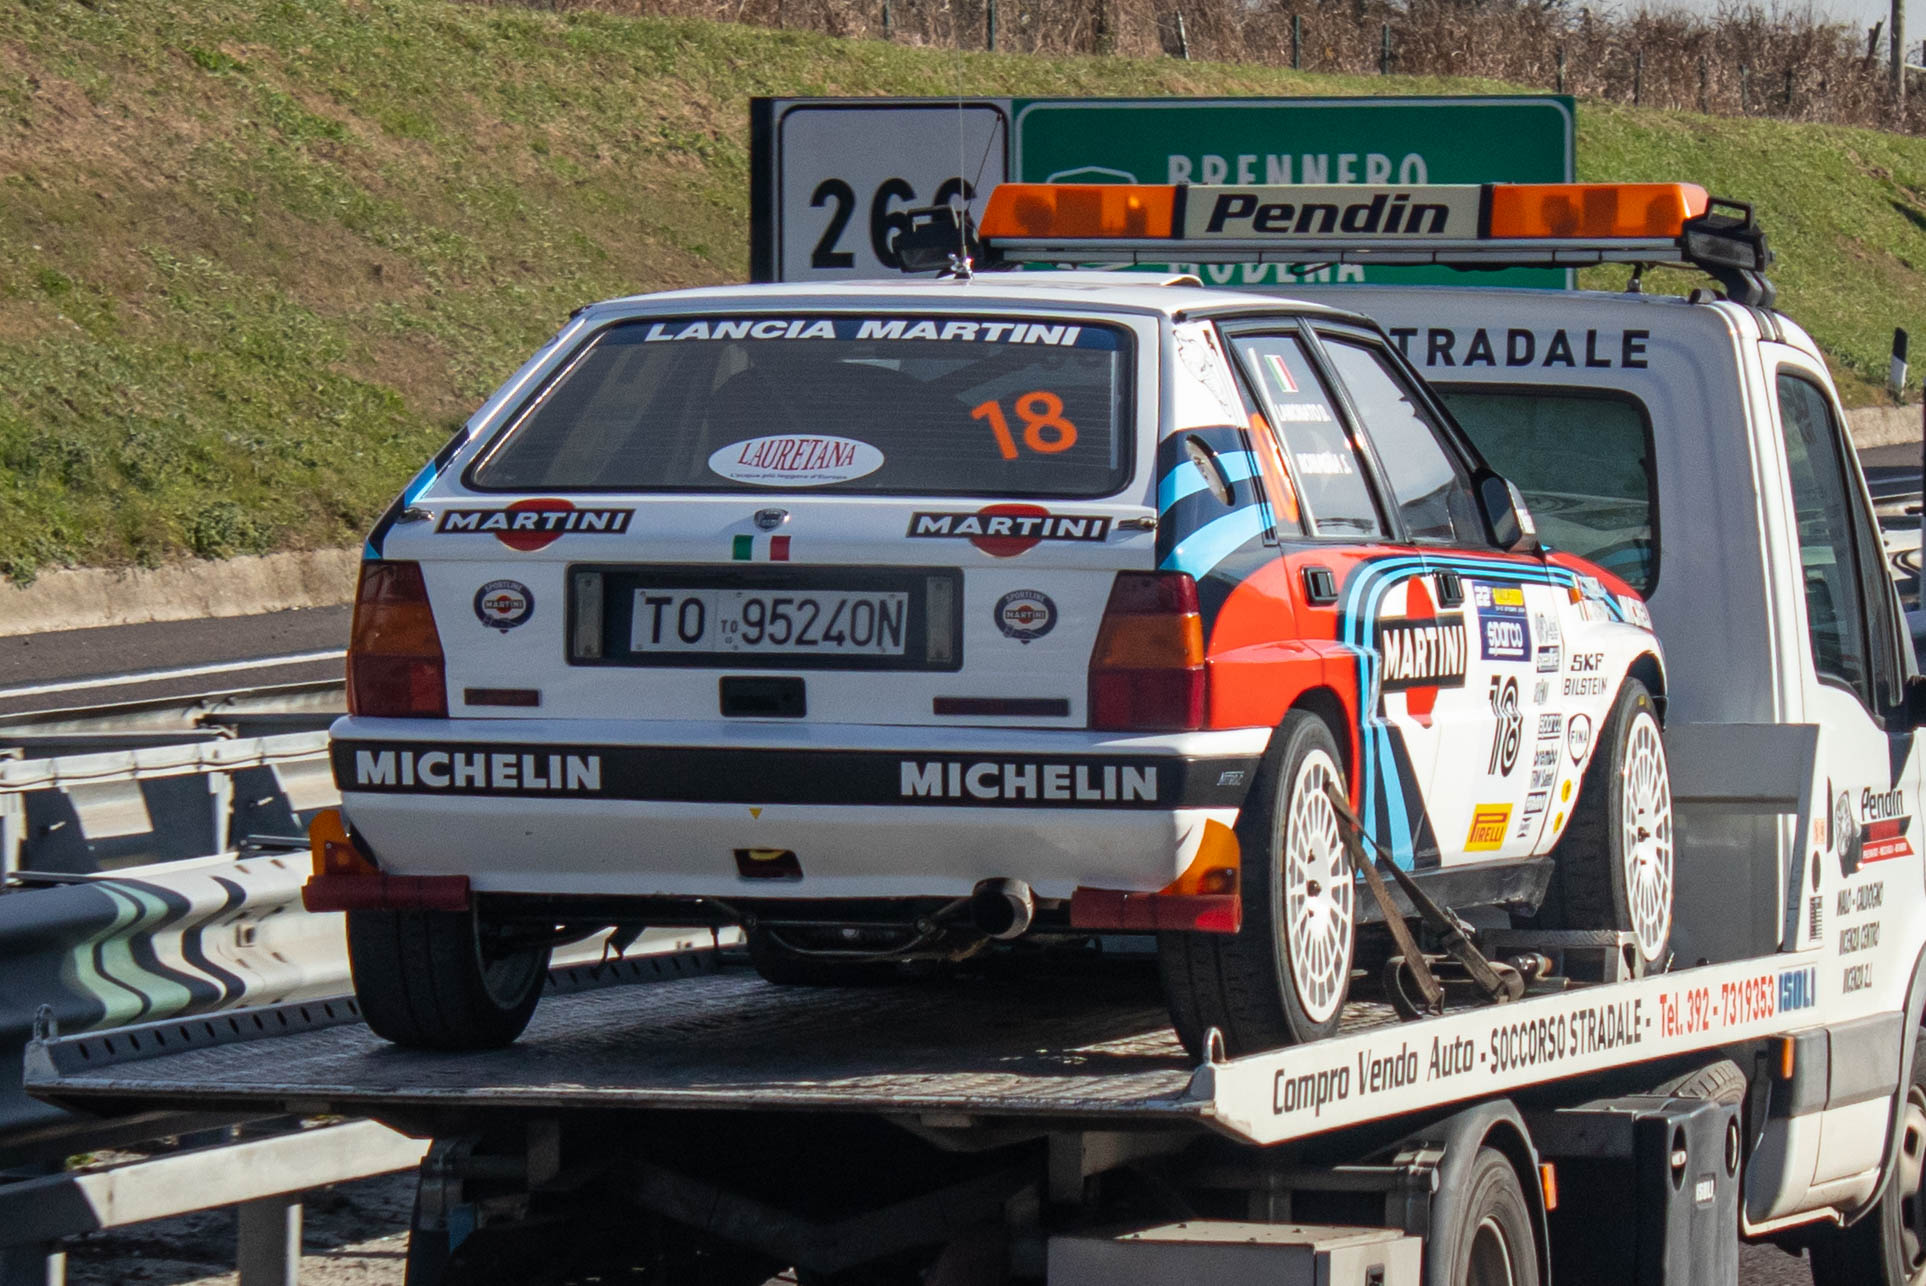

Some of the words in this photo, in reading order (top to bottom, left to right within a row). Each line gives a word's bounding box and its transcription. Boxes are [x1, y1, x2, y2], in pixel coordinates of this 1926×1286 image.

[1205, 193, 1450, 233] Pendin
[644, 320, 836, 343] LANCIA
[855, 321, 1083, 346] MARTINI
[971, 390, 1078, 460] 18
[737, 439, 857, 471] LAURETANA
[445, 511, 627, 531] MARTINI
[916, 515, 1102, 538] MARTINI
[485, 599, 523, 609] MARTINI
[1006, 609, 1046, 619] MARTINI
[645, 597, 706, 644] TO
[740, 598, 903, 648] 95240N
[1487, 620, 1524, 655] sparco
[1382, 625, 1466, 681] MARTINI
[1570, 653, 1604, 672] SKF
[1563, 677, 1608, 696] BILSTEIN
[1488, 675, 1523, 778] 18
[1570, 729, 1588, 744] FINA
[355, 750, 600, 790] MICHELIN
[900, 761, 1157, 801] MICHELIN
[1860, 786, 1905, 822] Pendin
[1469, 813, 1508, 843] PIRELLI
[1778, 966, 1817, 1014] ISOLI
[1273, 1065, 1350, 1117] Compro
[1358, 1042, 1418, 1096] Vendo
[1427, 1035, 1474, 1082] Auto
[1490, 1013, 1566, 1075] SOCCORSO
[1570, 998, 1642, 1057] STRADALE
[1659, 993, 1684, 1038] Tel.
